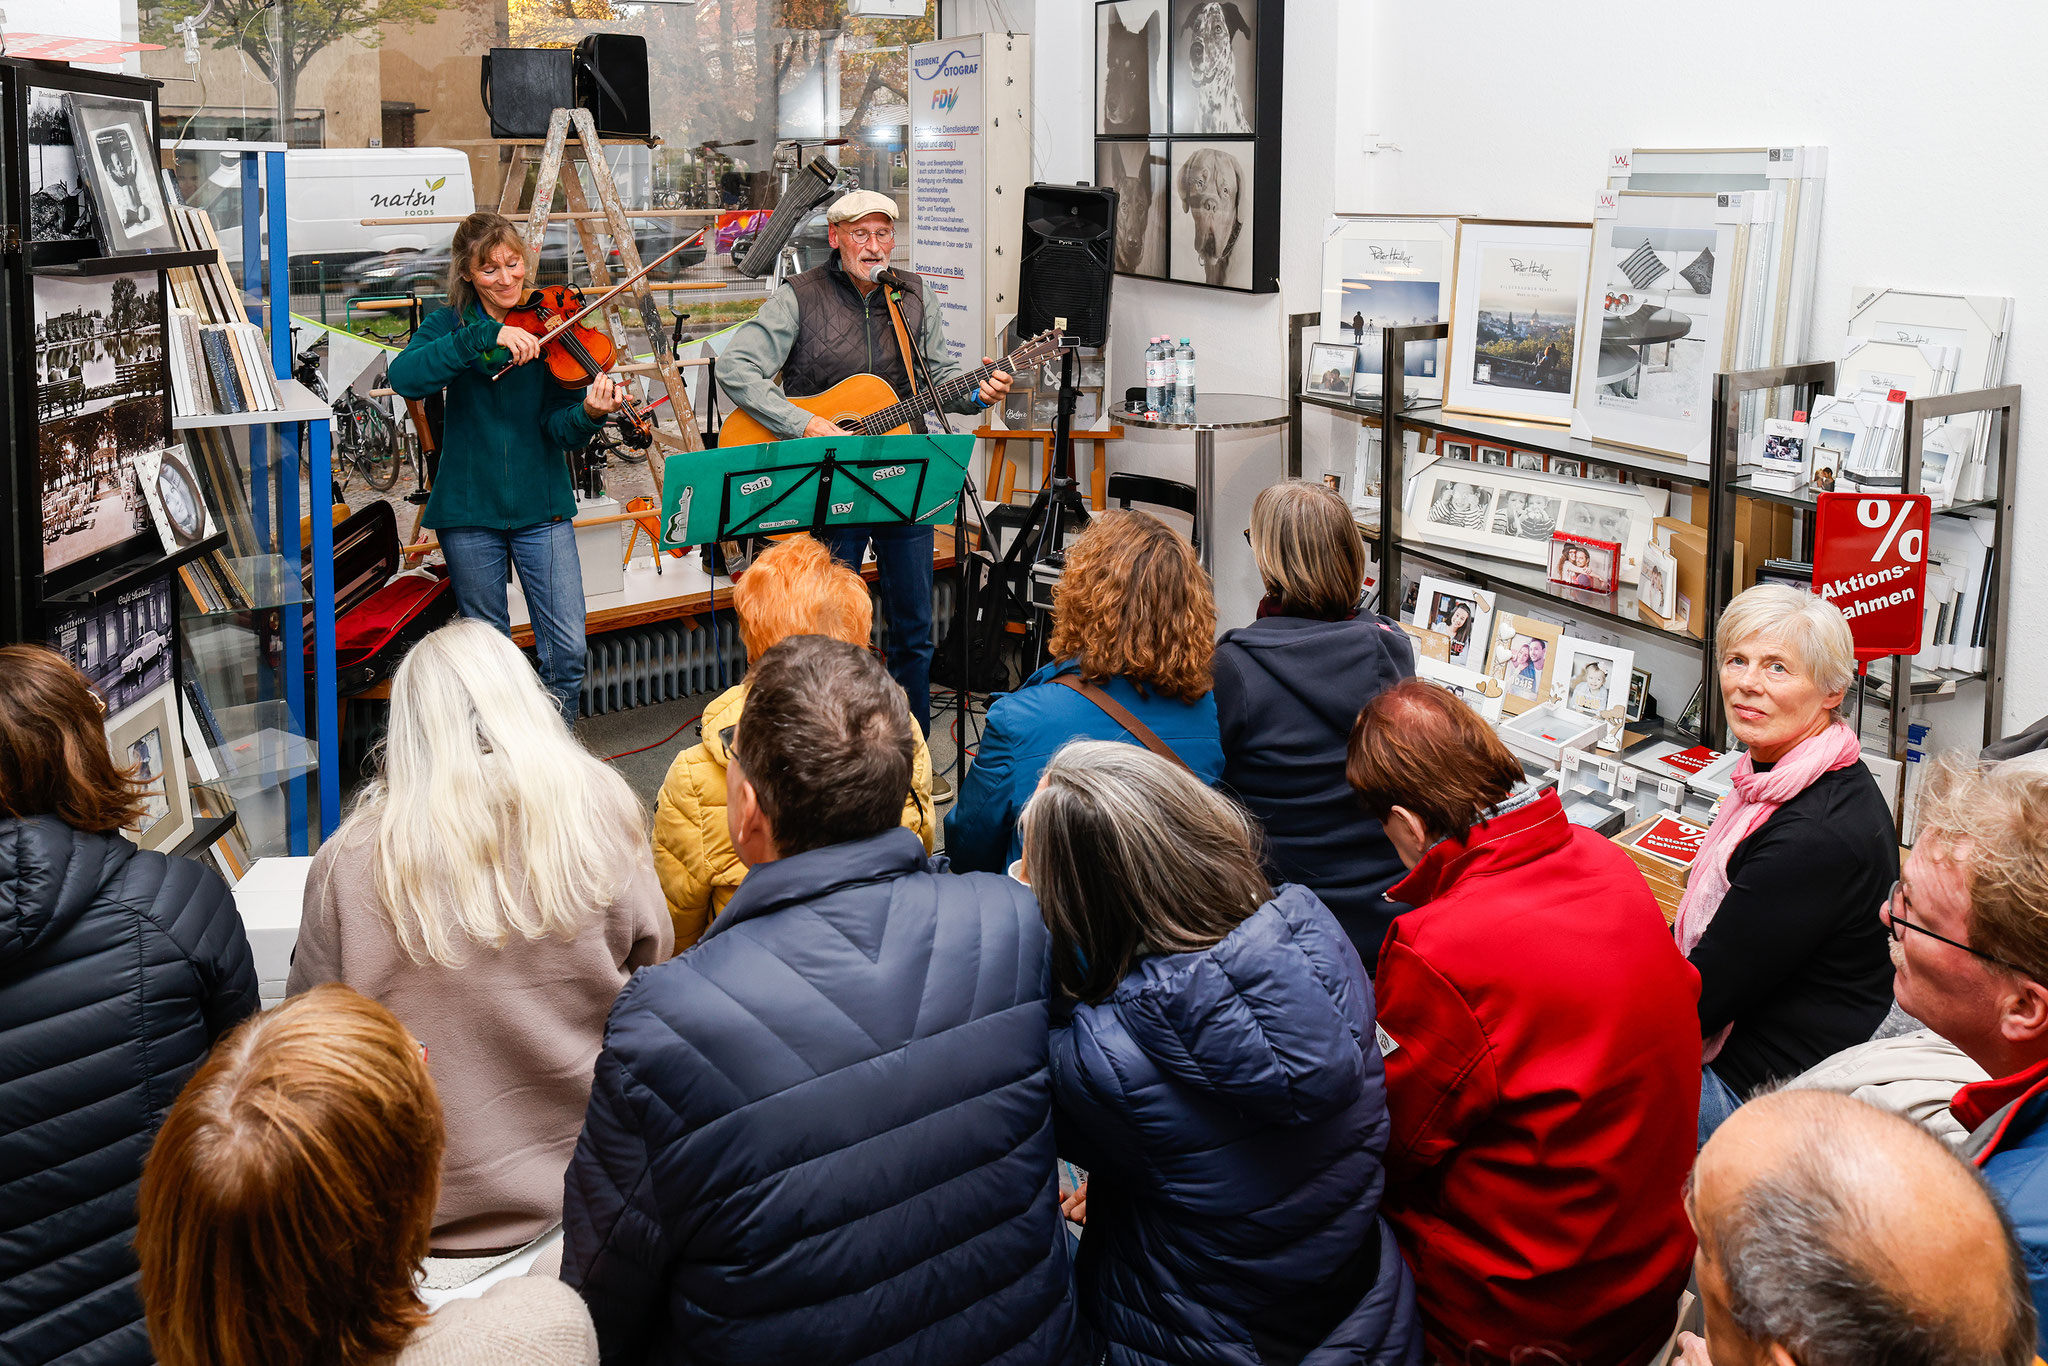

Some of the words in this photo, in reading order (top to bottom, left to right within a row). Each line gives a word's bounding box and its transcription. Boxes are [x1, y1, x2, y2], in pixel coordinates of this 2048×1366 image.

[914, 56, 940, 67] RESIDENZ
[942, 124, 979, 134] Dienstleistungen
[938, 140, 953, 149] analog
[915, 262, 932, 273] Service
[931, 266, 943, 274] rund
[943, 267, 954, 275] ums
[929, 280, 949, 291] Minuten
[874, 466, 904, 480] Side
[742, 477, 771, 495] Sait
[833, 502, 853, 514] By
[1821, 565, 1911, 600] Aktions-
[1842, 587, 1916, 620] ahmen
[54, 616, 87, 635] Schultheiss
[1669, 756, 1704, 768] Rahm
[1673, 753, 1711, 766] Aktion
[1647, 834, 1699, 848] Aktions-
[1647, 839, 1698, 853] Rahmen
